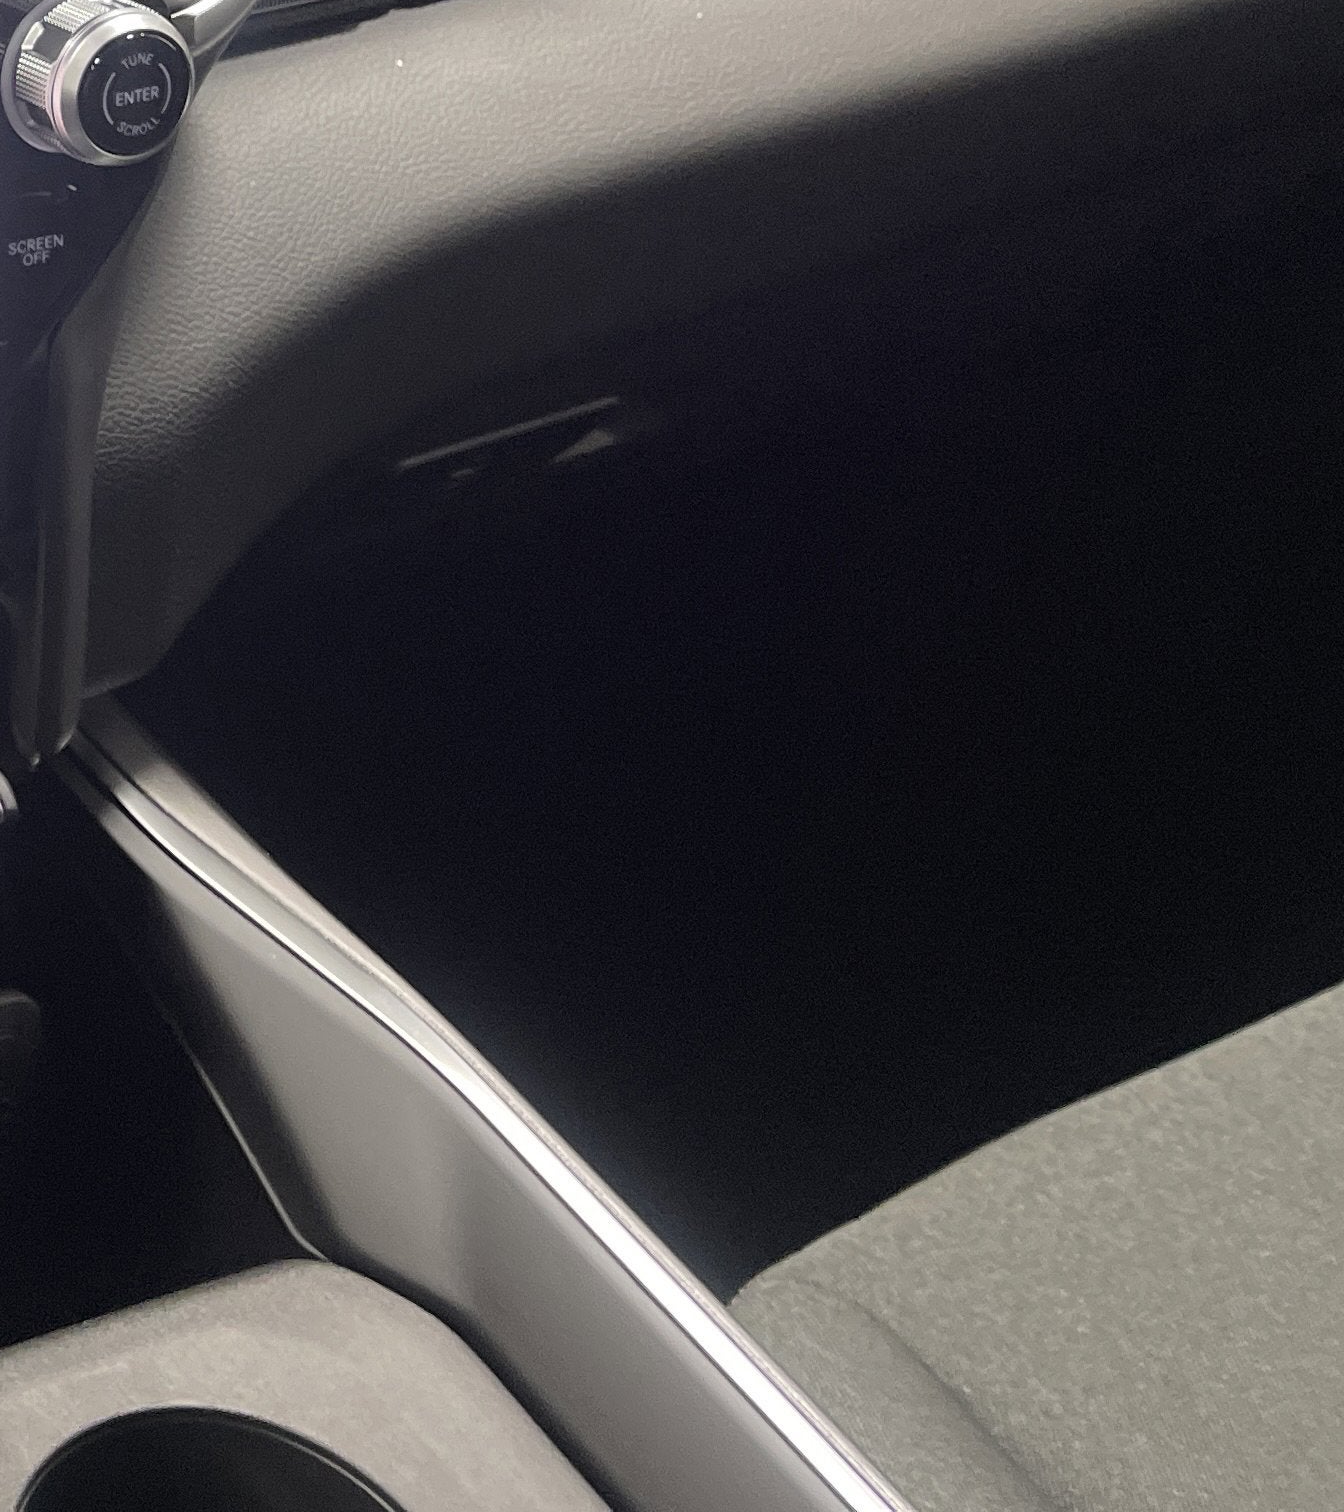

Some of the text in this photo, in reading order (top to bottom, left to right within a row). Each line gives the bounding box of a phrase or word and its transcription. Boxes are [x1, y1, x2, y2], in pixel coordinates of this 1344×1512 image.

[121, 51, 154, 70] TUNE
[115, 85, 160, 107] ENTER
[116, 117, 161, 137] SCROLL
[8, 234, 64, 256] SCREEN
[23, 253, 50, 267] OFF
